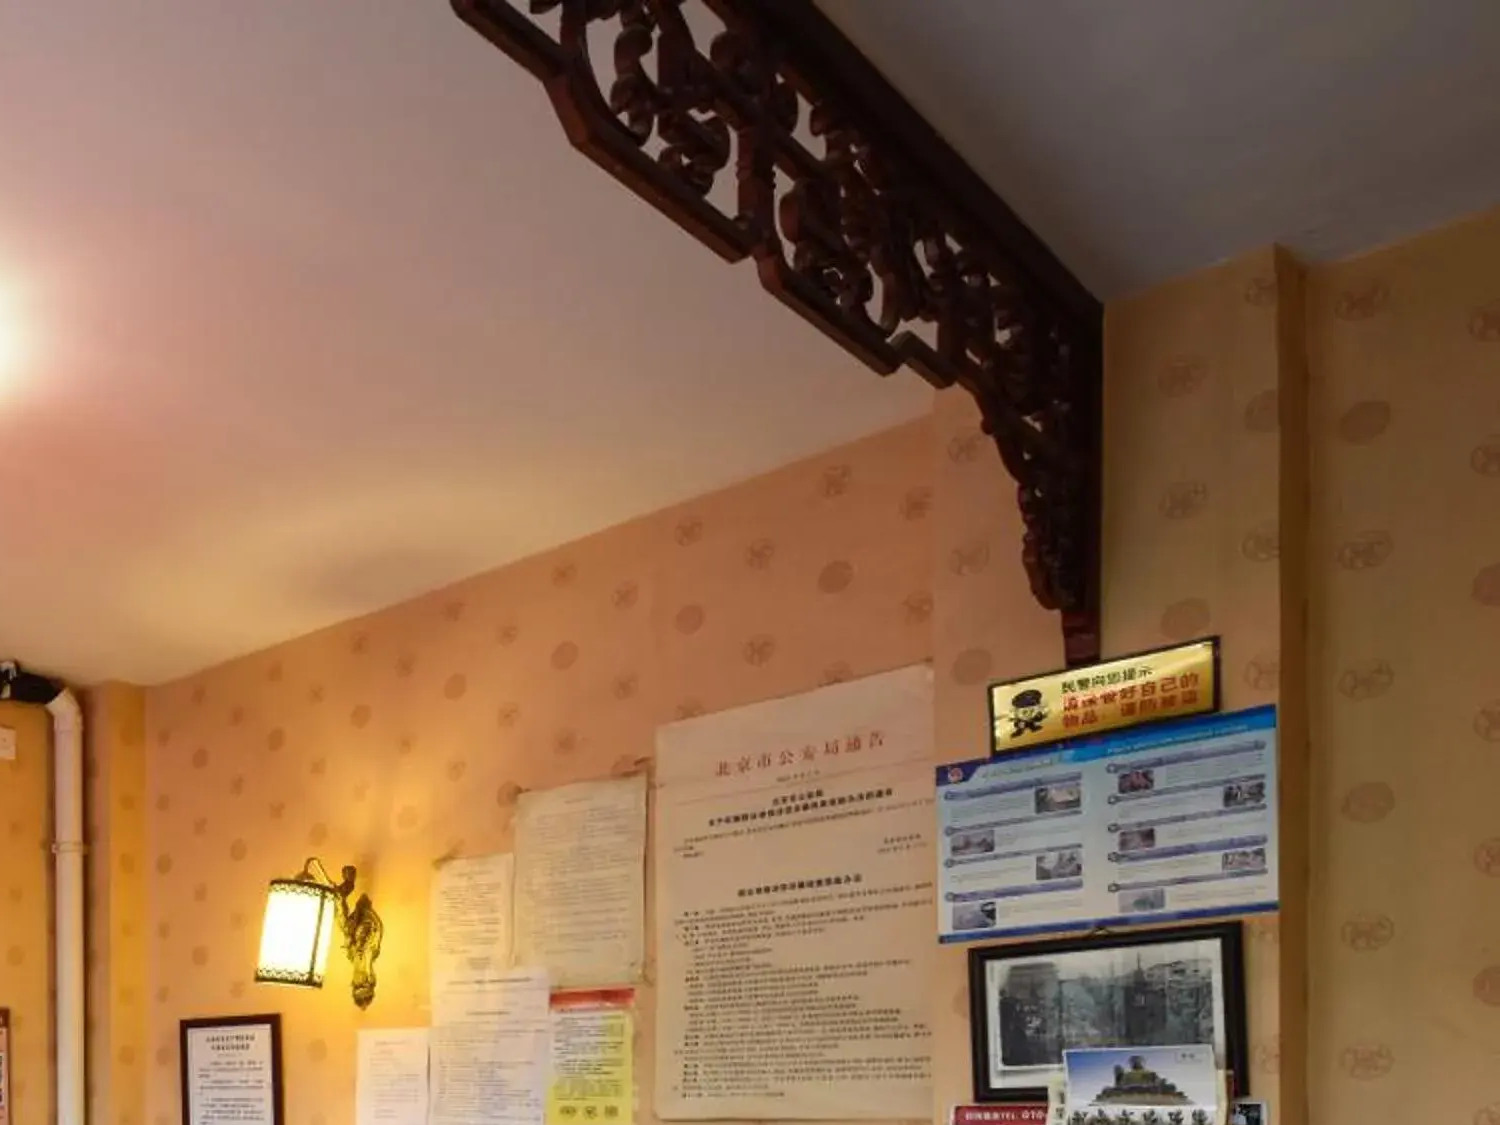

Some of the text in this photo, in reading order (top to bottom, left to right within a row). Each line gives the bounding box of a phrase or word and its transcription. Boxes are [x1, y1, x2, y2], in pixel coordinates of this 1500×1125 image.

[715, 731, 886, 777] 北京市公安局通告
